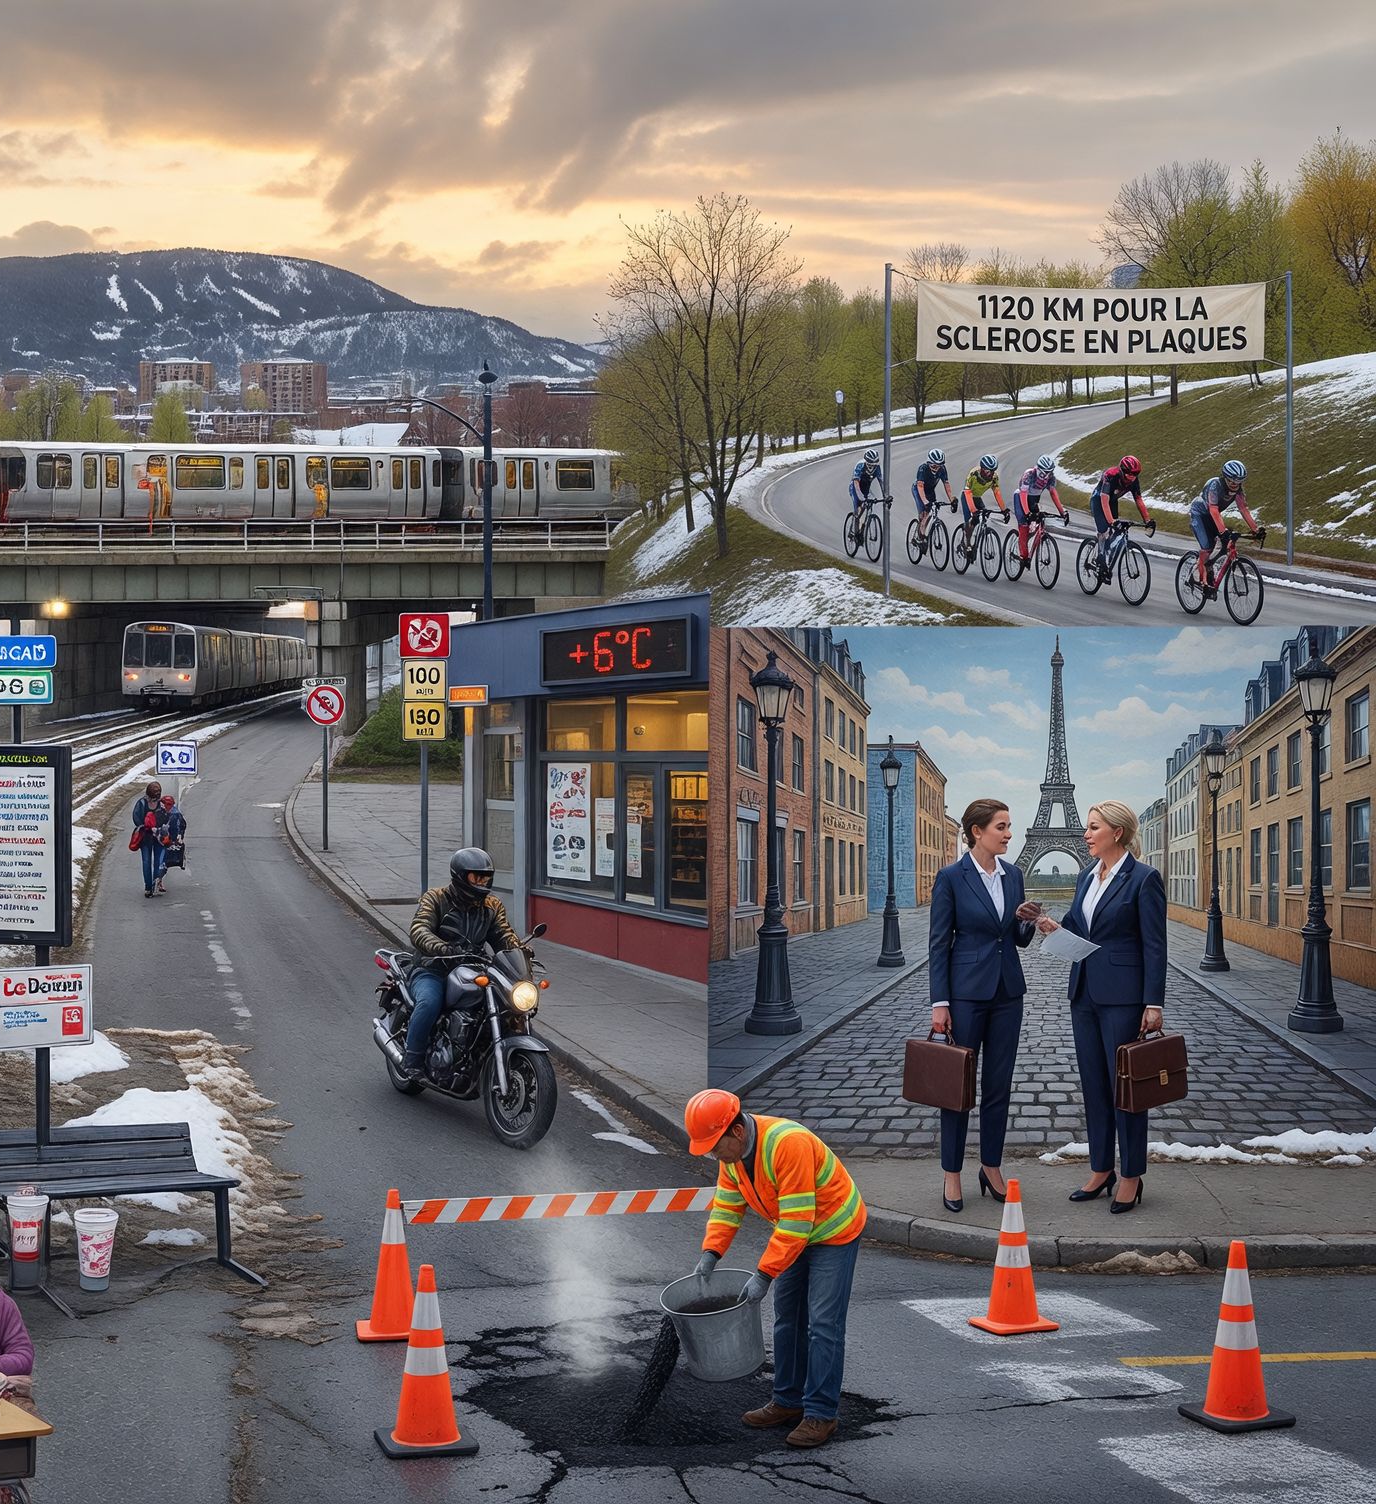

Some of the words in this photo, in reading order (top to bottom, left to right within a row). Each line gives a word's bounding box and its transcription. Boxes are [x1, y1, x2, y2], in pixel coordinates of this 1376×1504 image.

[977, 294, 1035, 321] 1120
[1043, 296, 1084, 322] KM
[1093, 296, 1167, 322] POUR
[1175, 296, 1209, 321] LA
[936, 324, 1076, 354] SCLEROSE
[1084, 328, 1119, 354] EN
[1128, 325, 1248, 354] PLAQUES
[408, 667, 441, 685] 100
